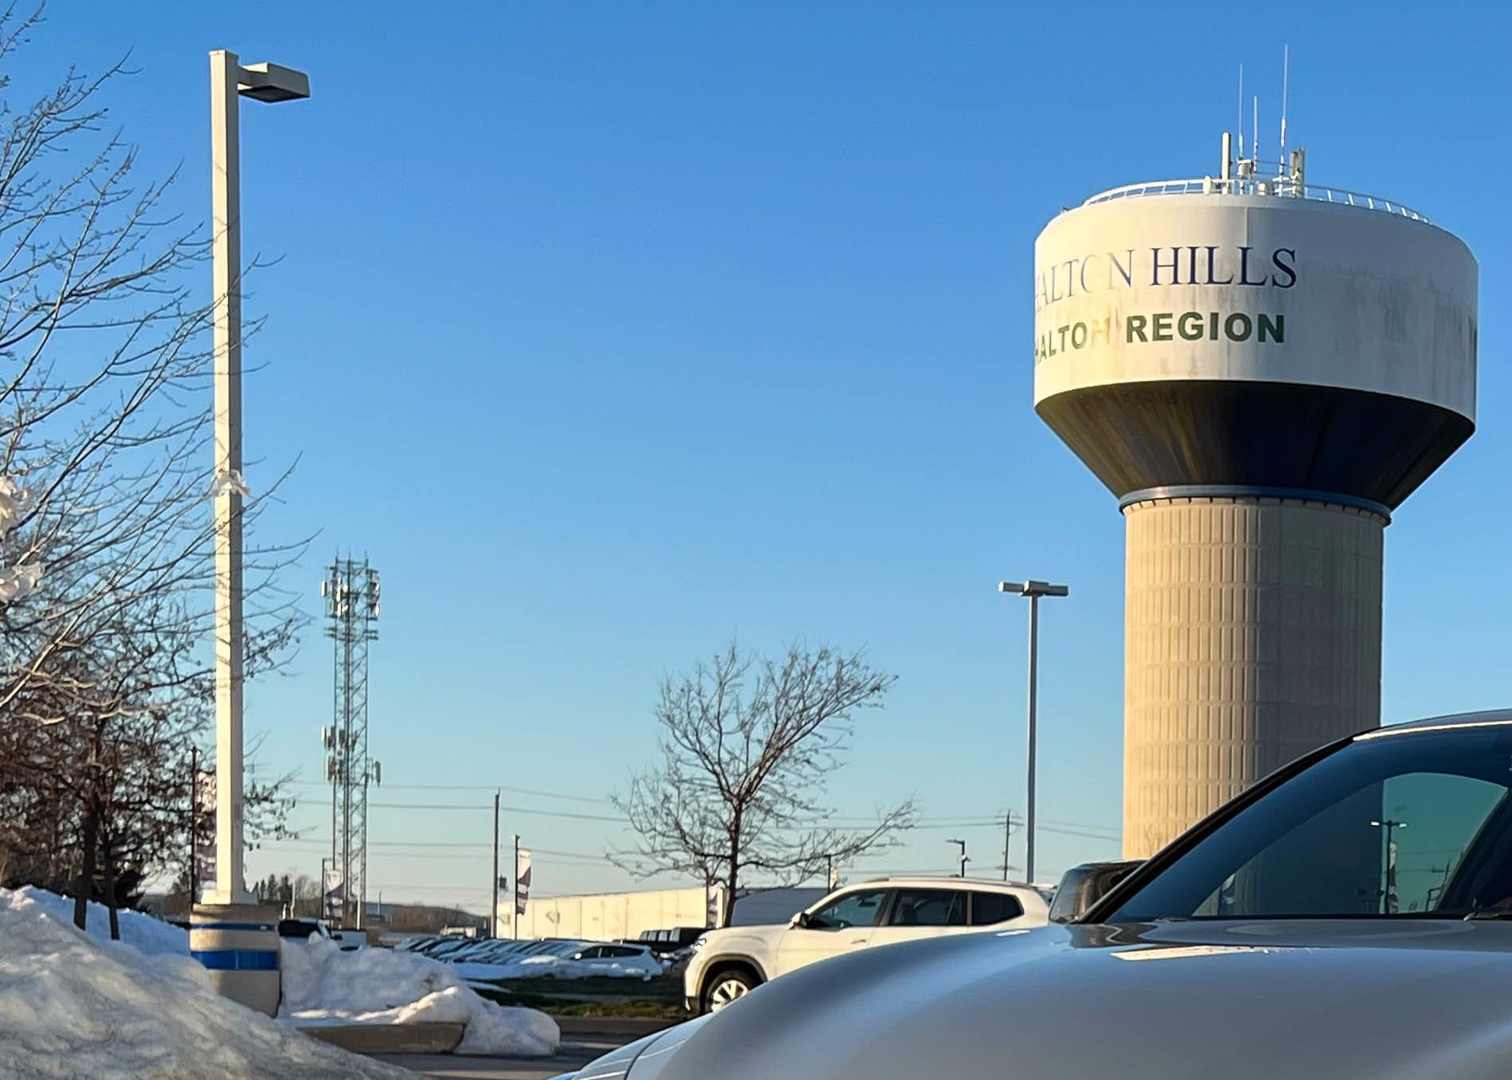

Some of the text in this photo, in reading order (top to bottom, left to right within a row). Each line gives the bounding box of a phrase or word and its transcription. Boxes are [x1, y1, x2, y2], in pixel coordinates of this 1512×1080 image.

[1036, 246, 1297, 312] ALTON HILLS
[1126, 312, 1285, 343] REGION
